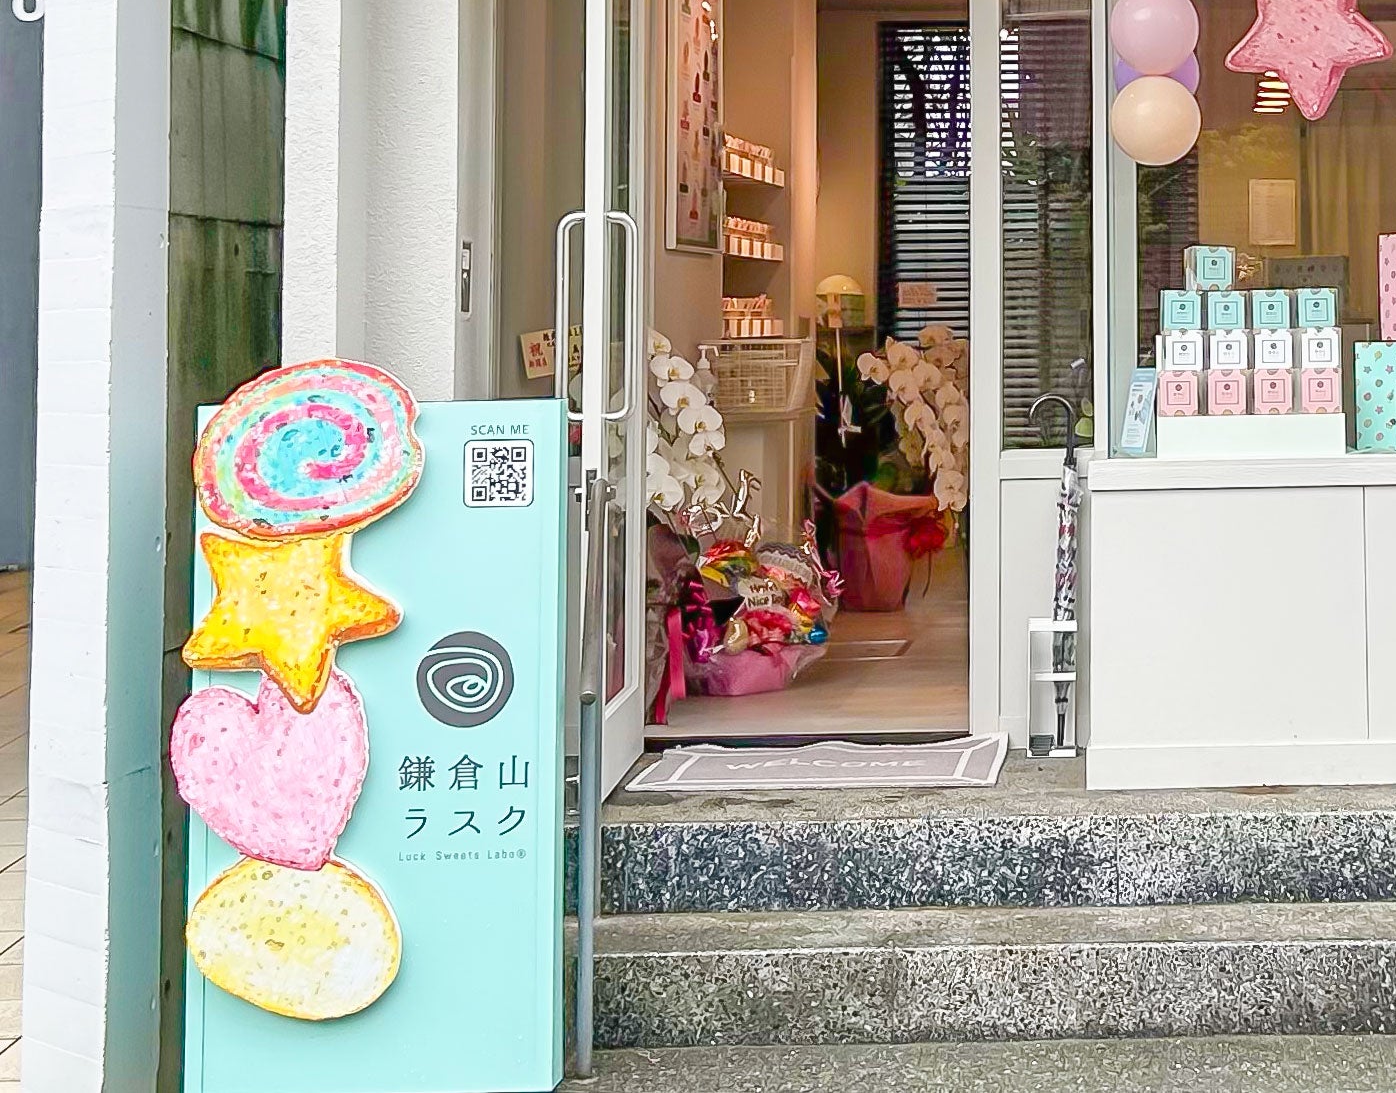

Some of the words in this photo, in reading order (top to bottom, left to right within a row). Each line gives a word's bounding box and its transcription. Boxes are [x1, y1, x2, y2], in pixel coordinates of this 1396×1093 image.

[471, 424, 505, 436] SCAN
[510, 424, 530, 435] ME
[726, 757, 927, 770] WELCOME
[398, 754, 530, 792] 鎌倉山
[405, 805, 526, 840] ラスク
[399, 852, 426, 862] Luck
[436, 850, 480, 861] Sweets
